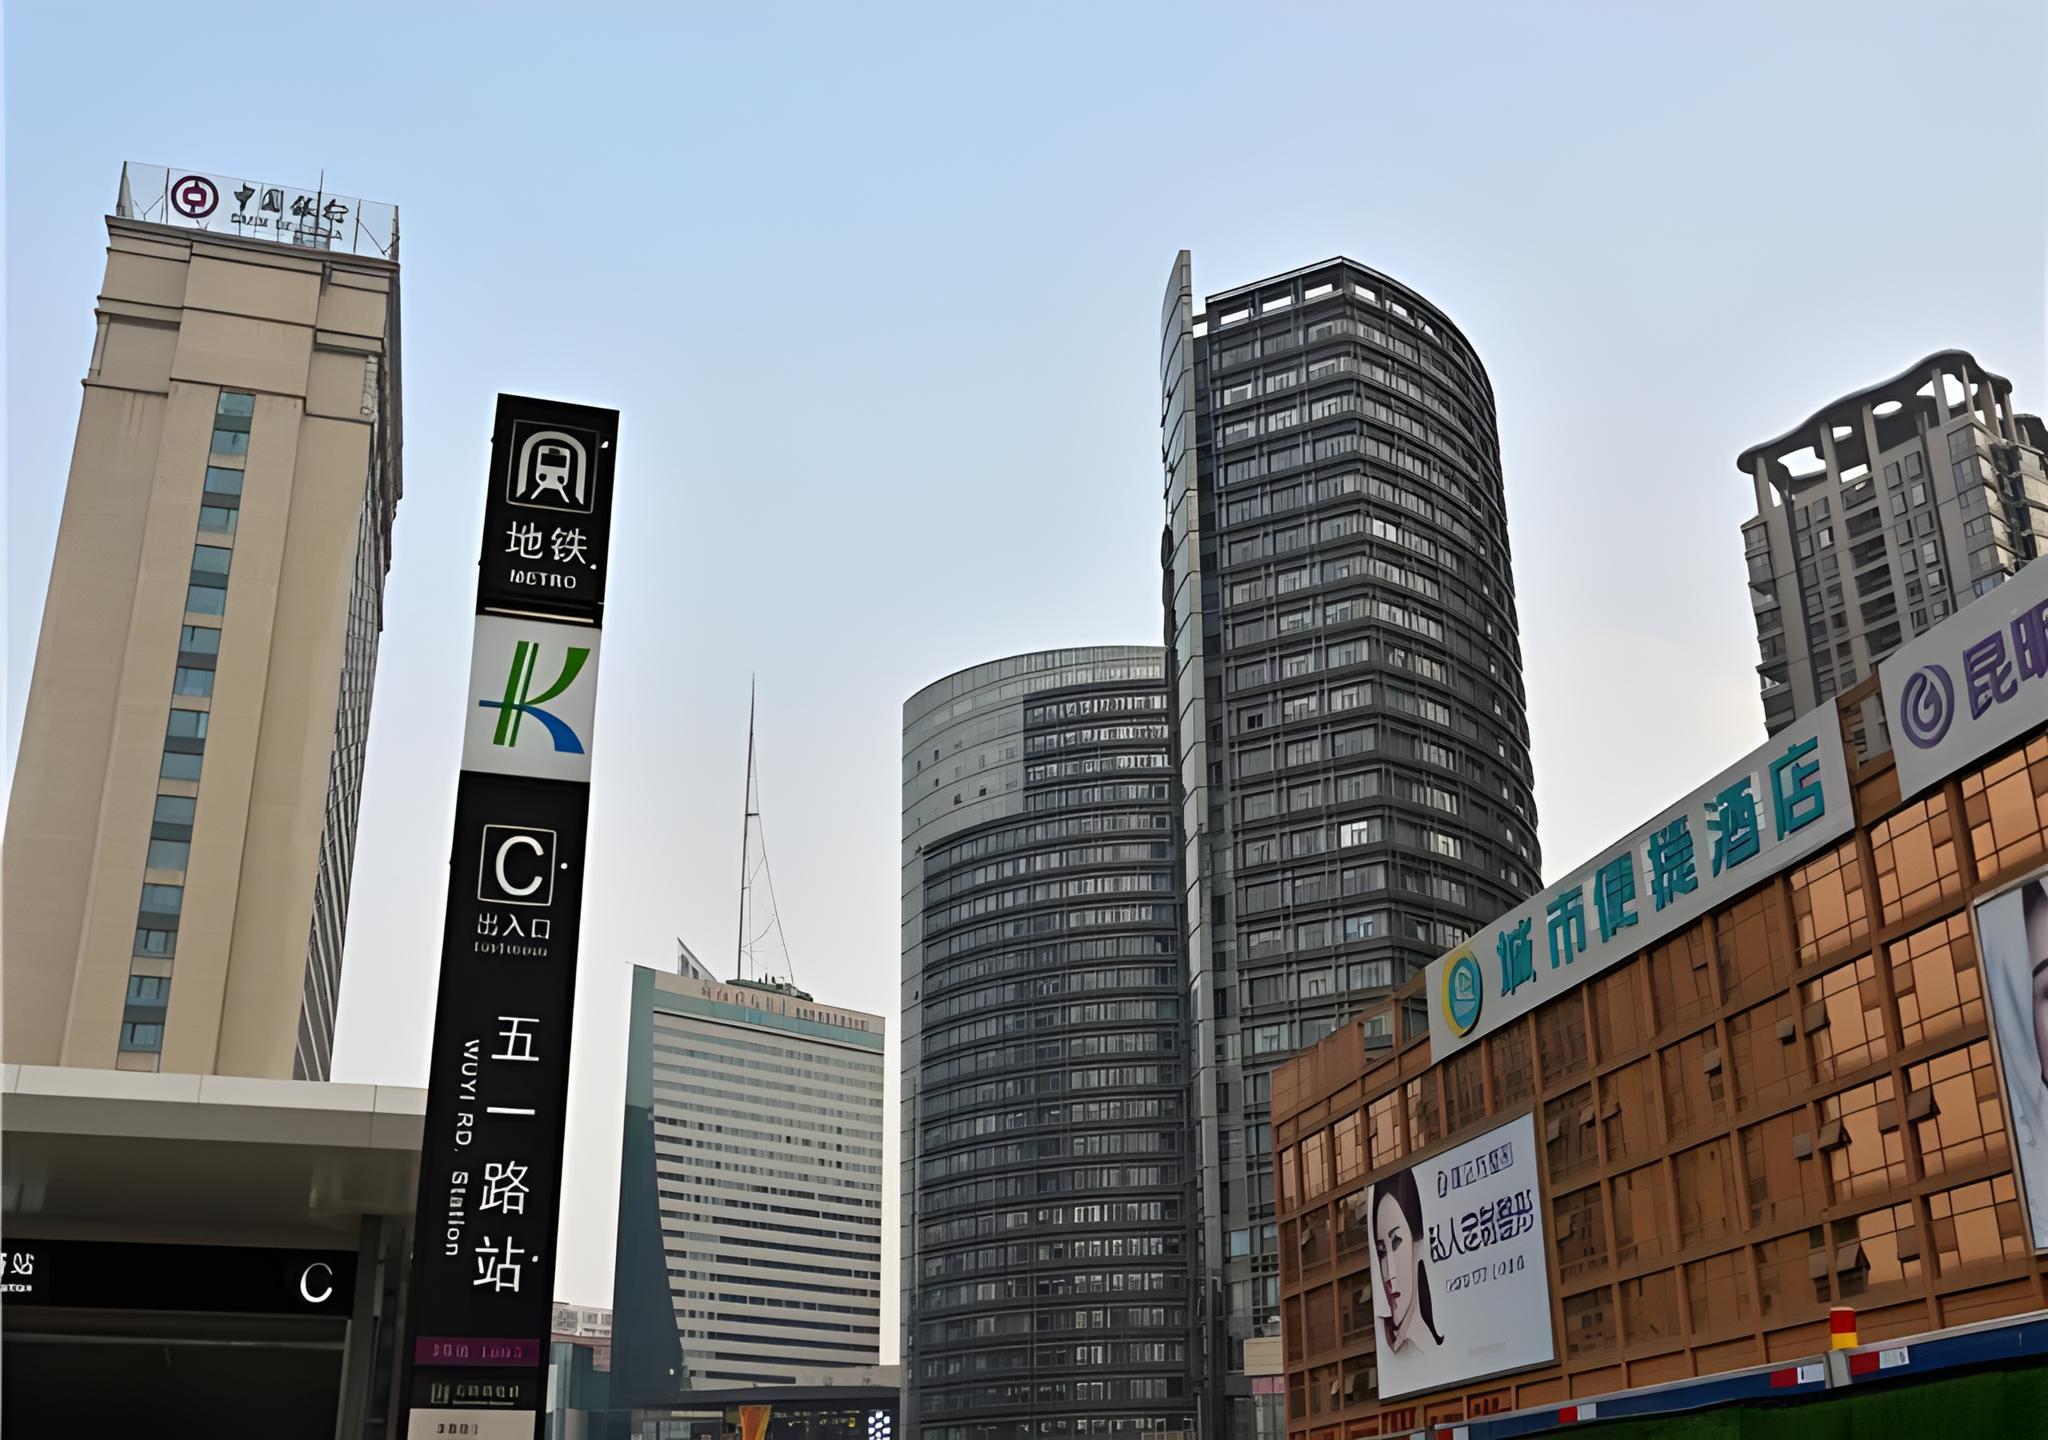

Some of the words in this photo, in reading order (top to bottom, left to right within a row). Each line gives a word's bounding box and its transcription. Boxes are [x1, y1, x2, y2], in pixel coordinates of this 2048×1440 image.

[505, 520, 588, 564] 地铁
[495, 835, 544, 896] C
[1496, 736, 1825, 997] 城市便捷酒店
[477, 912, 550, 940] 出入口
[459, 1039, 480, 1101] WUYI
[473, 1015, 541, 1292] 五一路站
[299, 1261, 333, 1303] C
